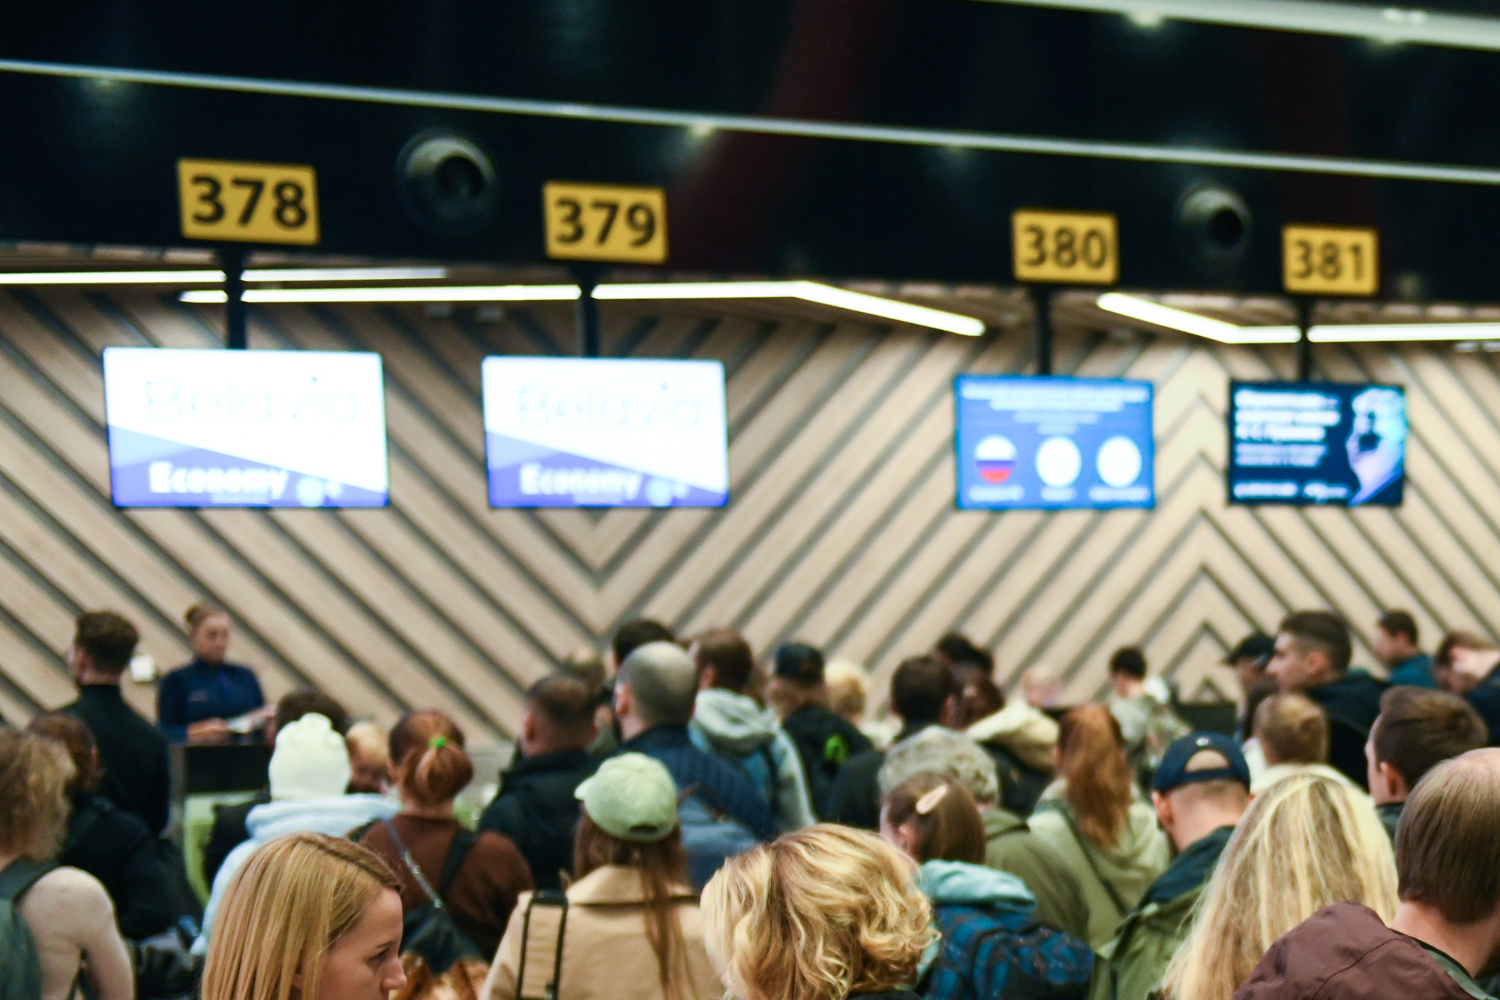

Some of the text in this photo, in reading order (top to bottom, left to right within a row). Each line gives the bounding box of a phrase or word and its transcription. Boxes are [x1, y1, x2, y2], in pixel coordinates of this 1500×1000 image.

[190, 173, 308, 230] 378
[555, 197, 656, 248] 379
[1024, 223, 1108, 270] 380
[1293, 238, 1365, 282] 381
[145, 374, 358, 424] Belavia
[516, 382, 703, 430] Belavia
[149, 461, 289, 499] Economy
[519, 462, 642, 501] Economy
